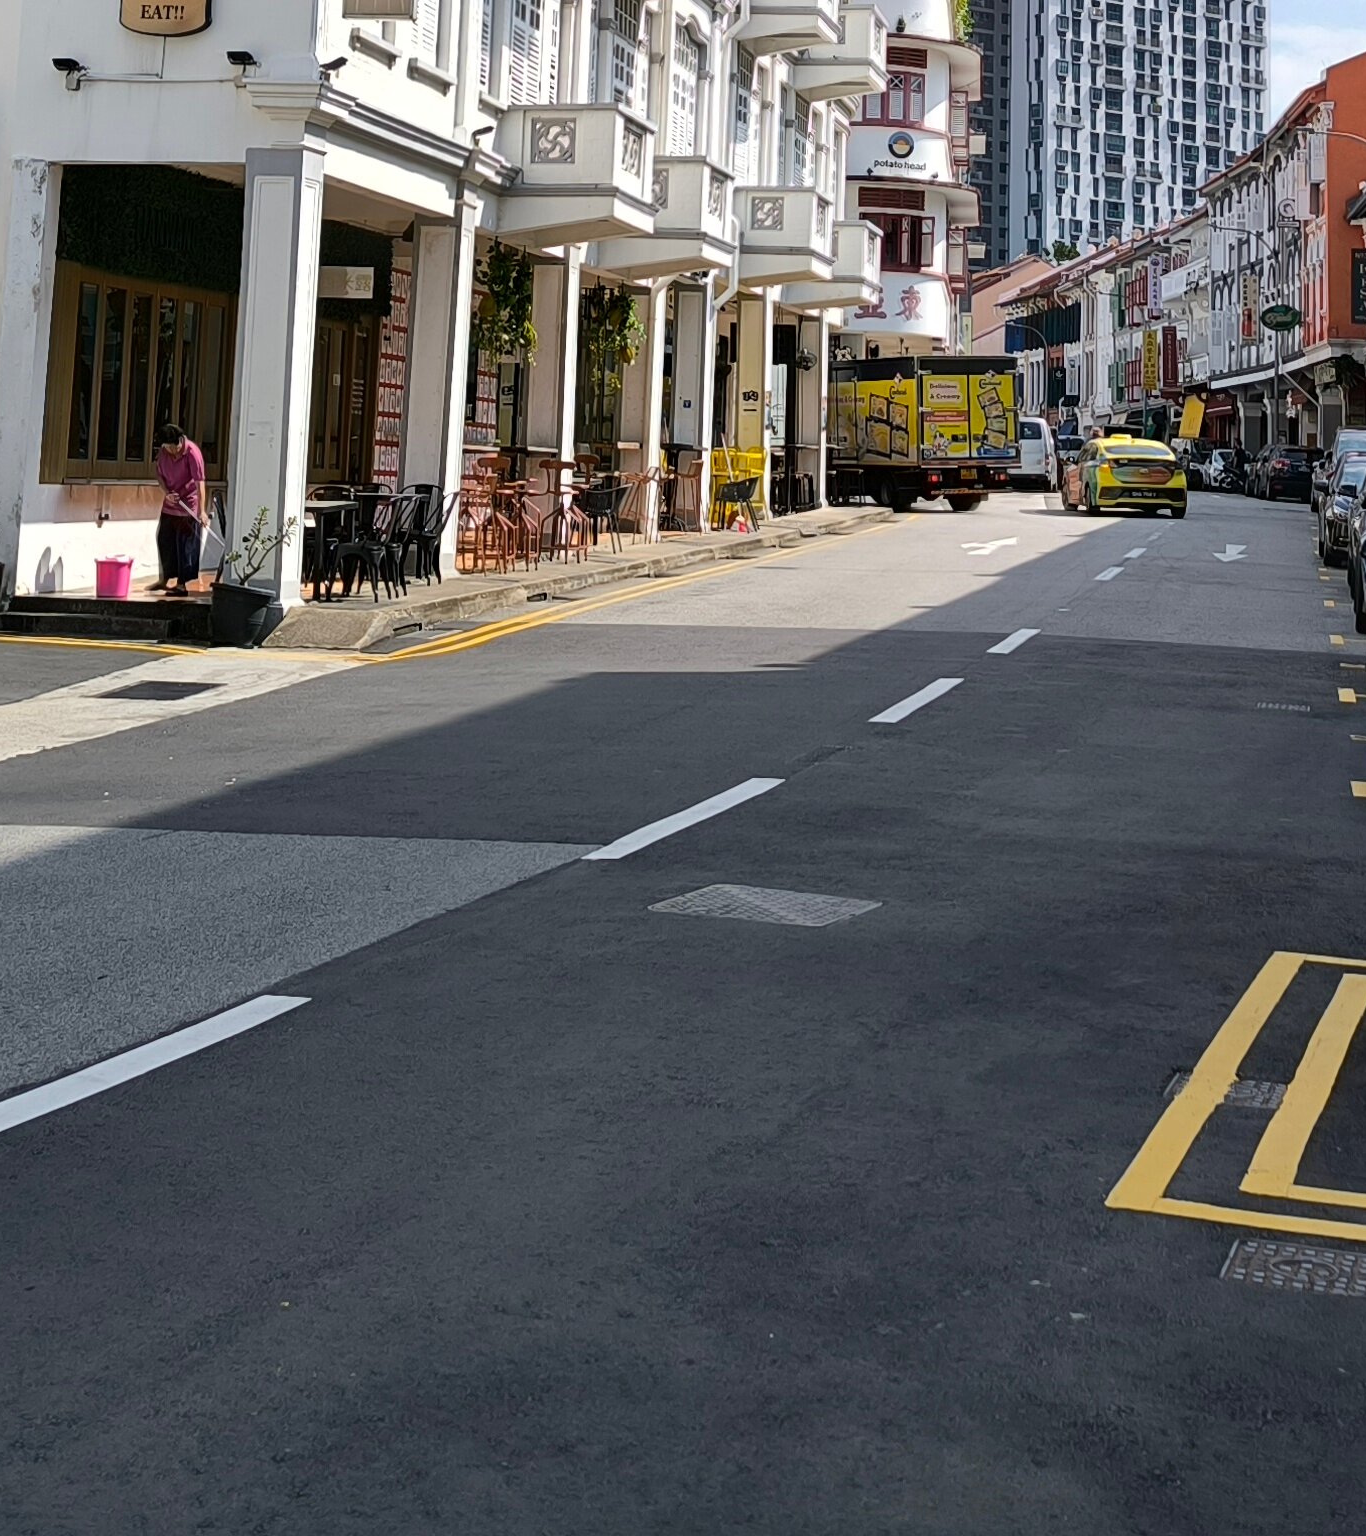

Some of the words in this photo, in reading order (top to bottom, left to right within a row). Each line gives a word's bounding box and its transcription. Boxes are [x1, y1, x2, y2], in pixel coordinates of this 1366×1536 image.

[140, 4, 185, 20] EAT!!
[873, 158, 903, 170] potato
[904, 160, 926, 171] head
